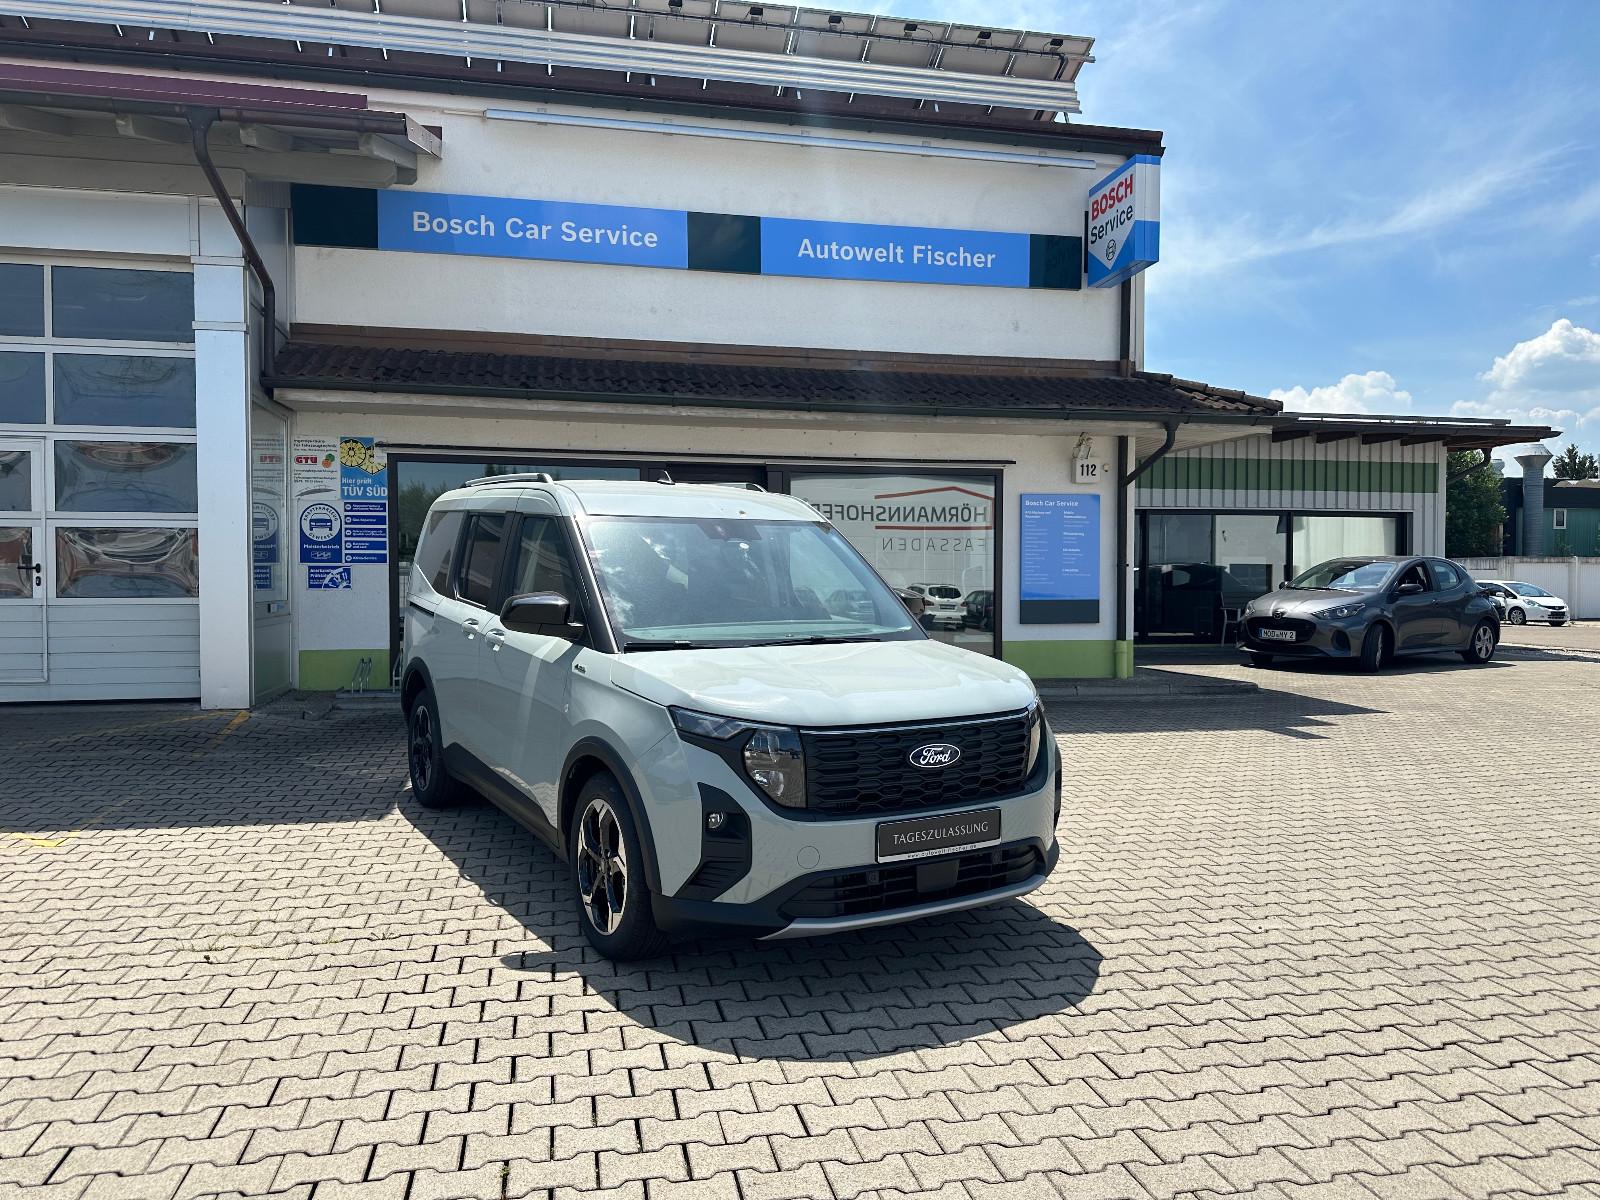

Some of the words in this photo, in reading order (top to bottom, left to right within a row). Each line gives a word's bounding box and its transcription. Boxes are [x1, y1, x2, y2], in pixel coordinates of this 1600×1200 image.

[1091, 173, 1134, 221] BOSCH
[412, 211, 495, 237] Bosch
[505, 217, 552, 240] Car
[560, 221, 658, 248] Service
[1090, 205, 1134, 245] Service
[797, 238, 904, 263] Autowelt
[913, 245, 996, 267] Fischer
[356, 477, 372, 486] prüft
[1080, 464, 1096, 476] 112
[342, 485, 364, 497] TÜV
[366, 485, 388, 497] SÜD
[920, 747, 951, 765] Ford
[893, 821, 989, 845] TAGESZULASSUNG
